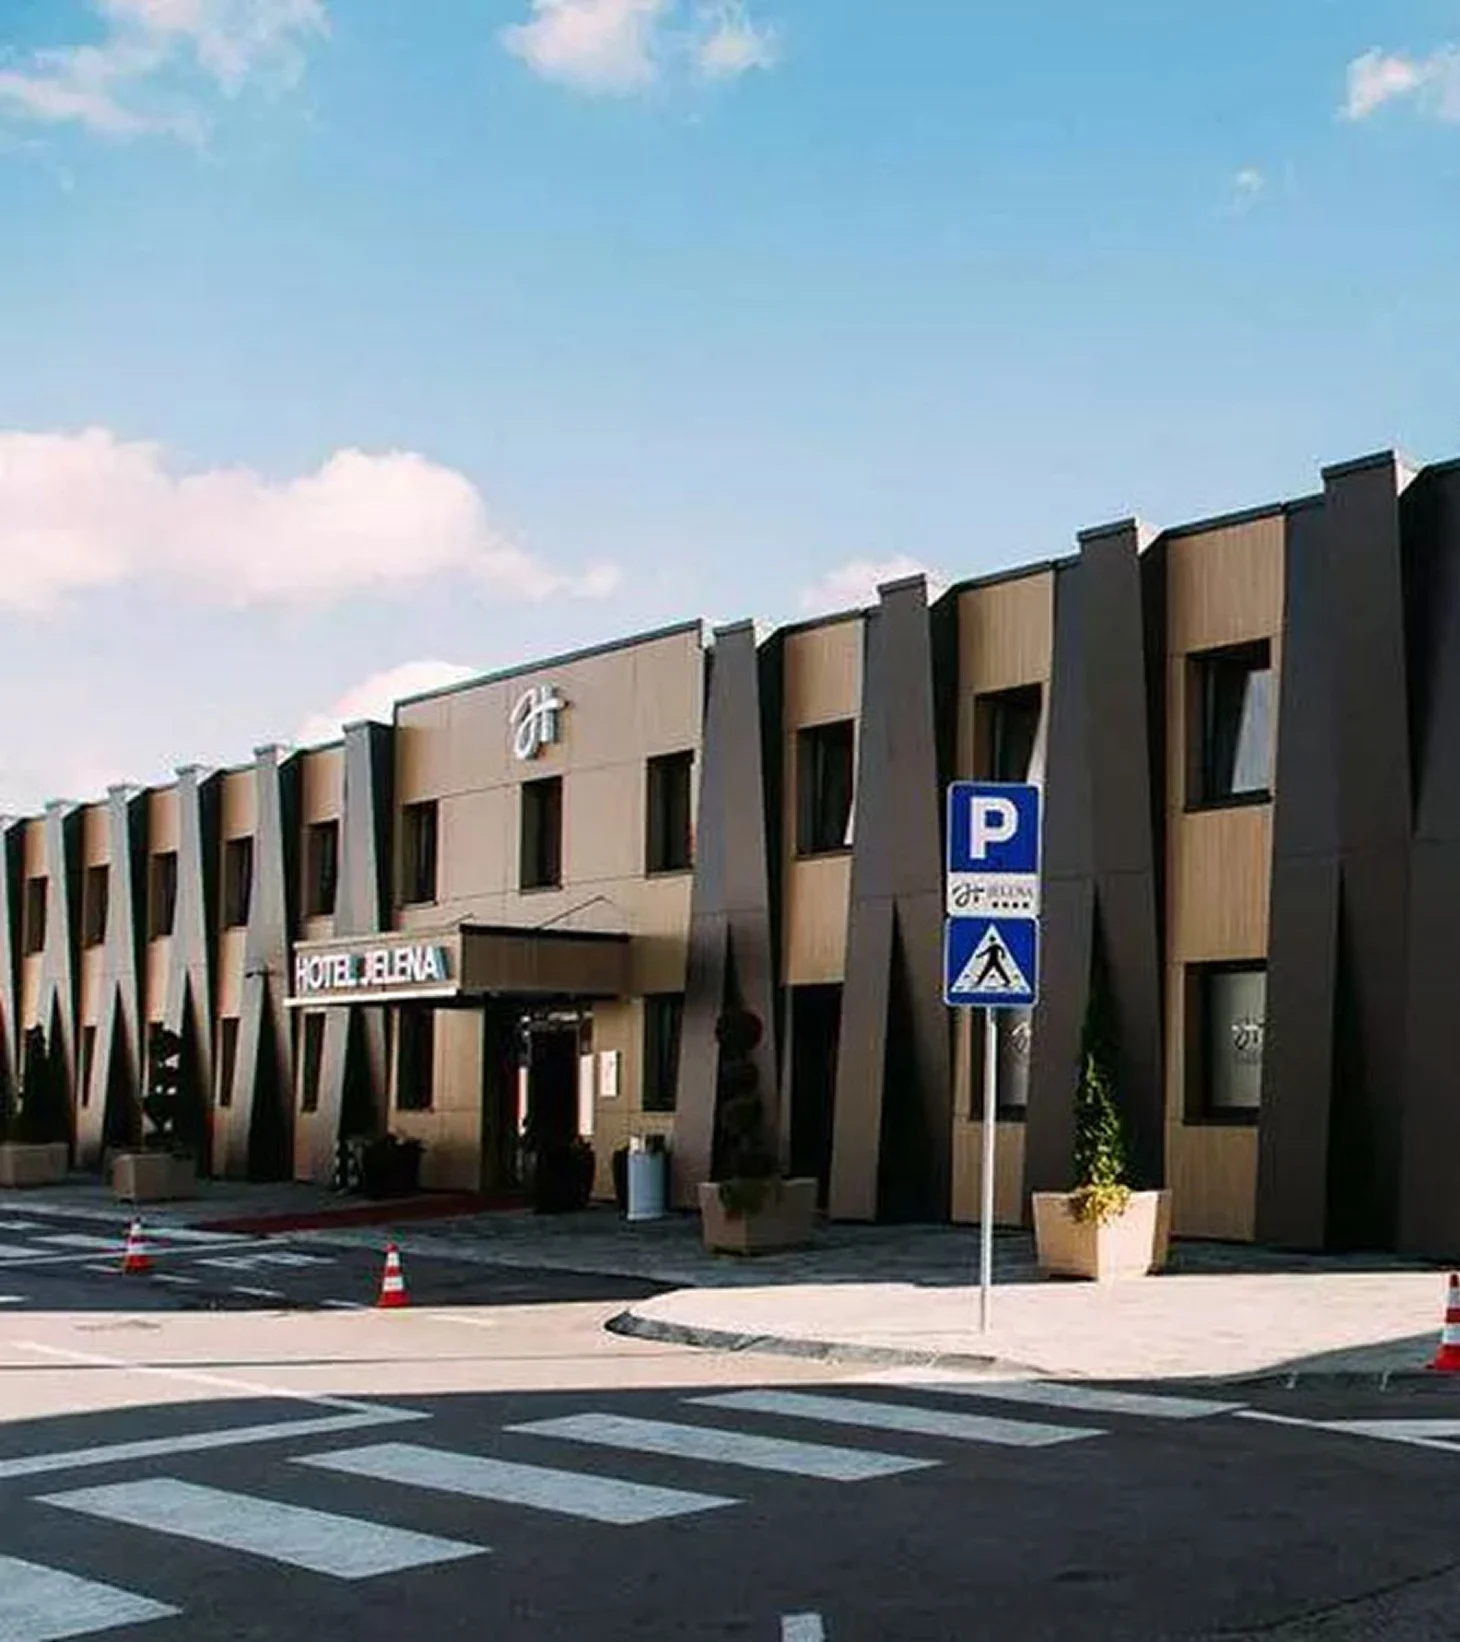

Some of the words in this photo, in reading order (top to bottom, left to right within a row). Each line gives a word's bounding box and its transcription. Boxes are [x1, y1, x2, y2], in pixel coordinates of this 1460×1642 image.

[970, 796, 1018, 860] P
[296, 952, 357, 992] HOTEL
[358, 945, 444, 985] JELENA
